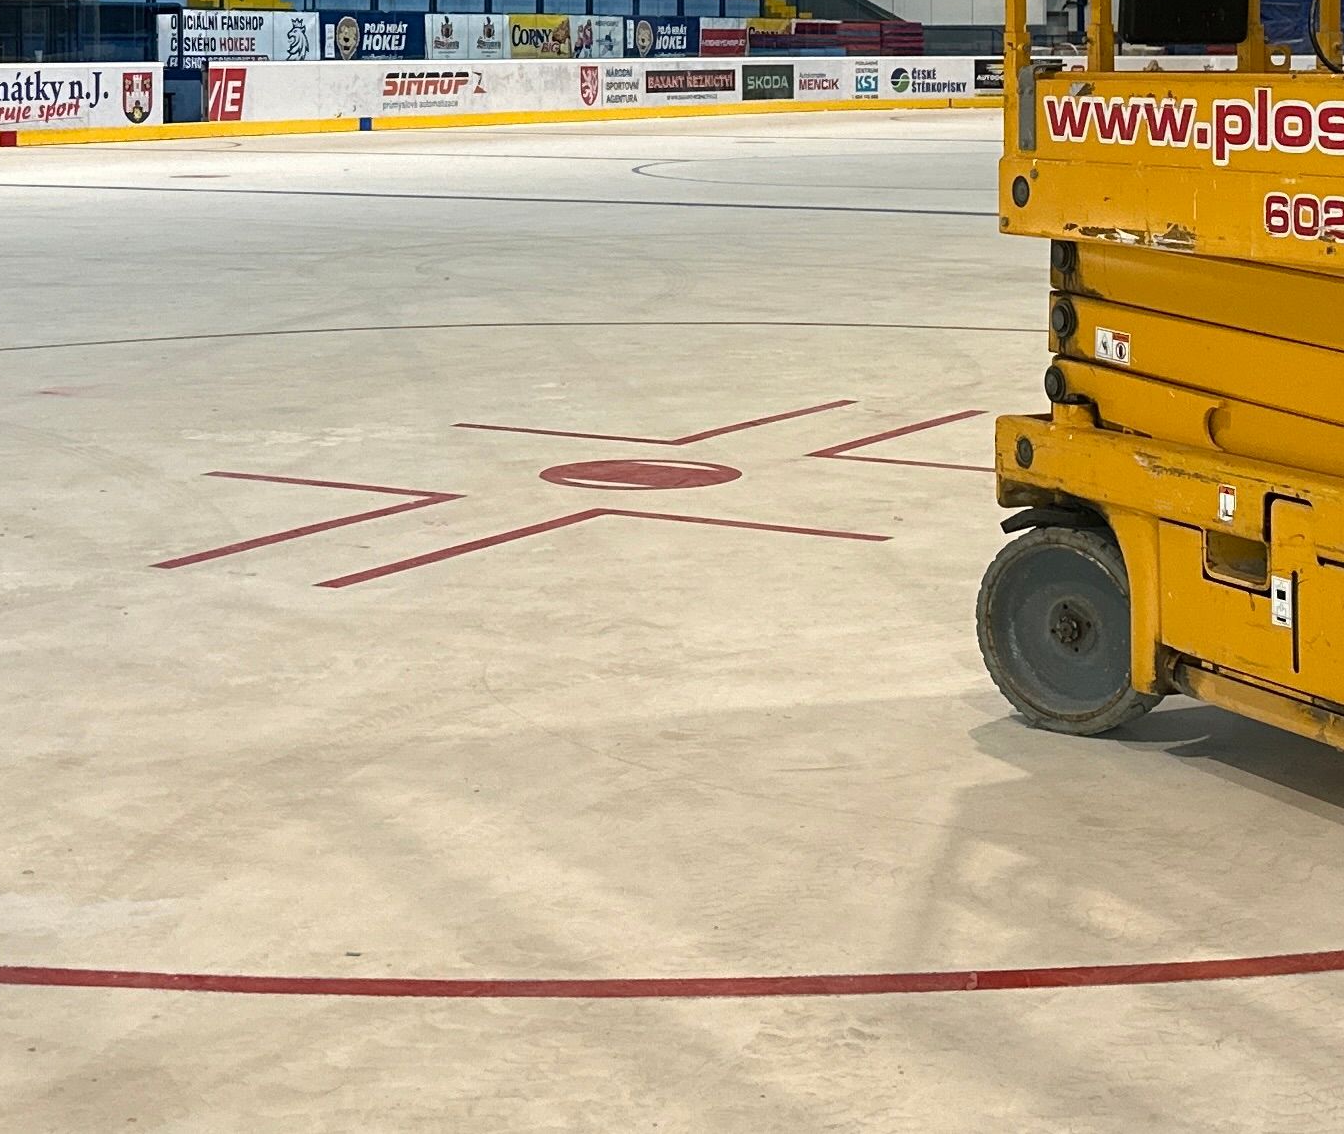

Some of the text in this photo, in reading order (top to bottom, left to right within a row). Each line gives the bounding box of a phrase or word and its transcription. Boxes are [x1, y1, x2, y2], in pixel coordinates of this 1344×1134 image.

[171, 12, 264, 31] OICIÁLNÍ FANSHOP
[170, 33, 256, 52] ČSKÉHO HOKEJE
[362, 34, 407, 51] HOKEJ
[655, 35, 687, 50] HOKEJ
[911, 67, 937, 79] ČESKÉ
[911, 78, 967, 93] ŠTĚRKOPÍSKY
[38, 98, 81, 120] sport
